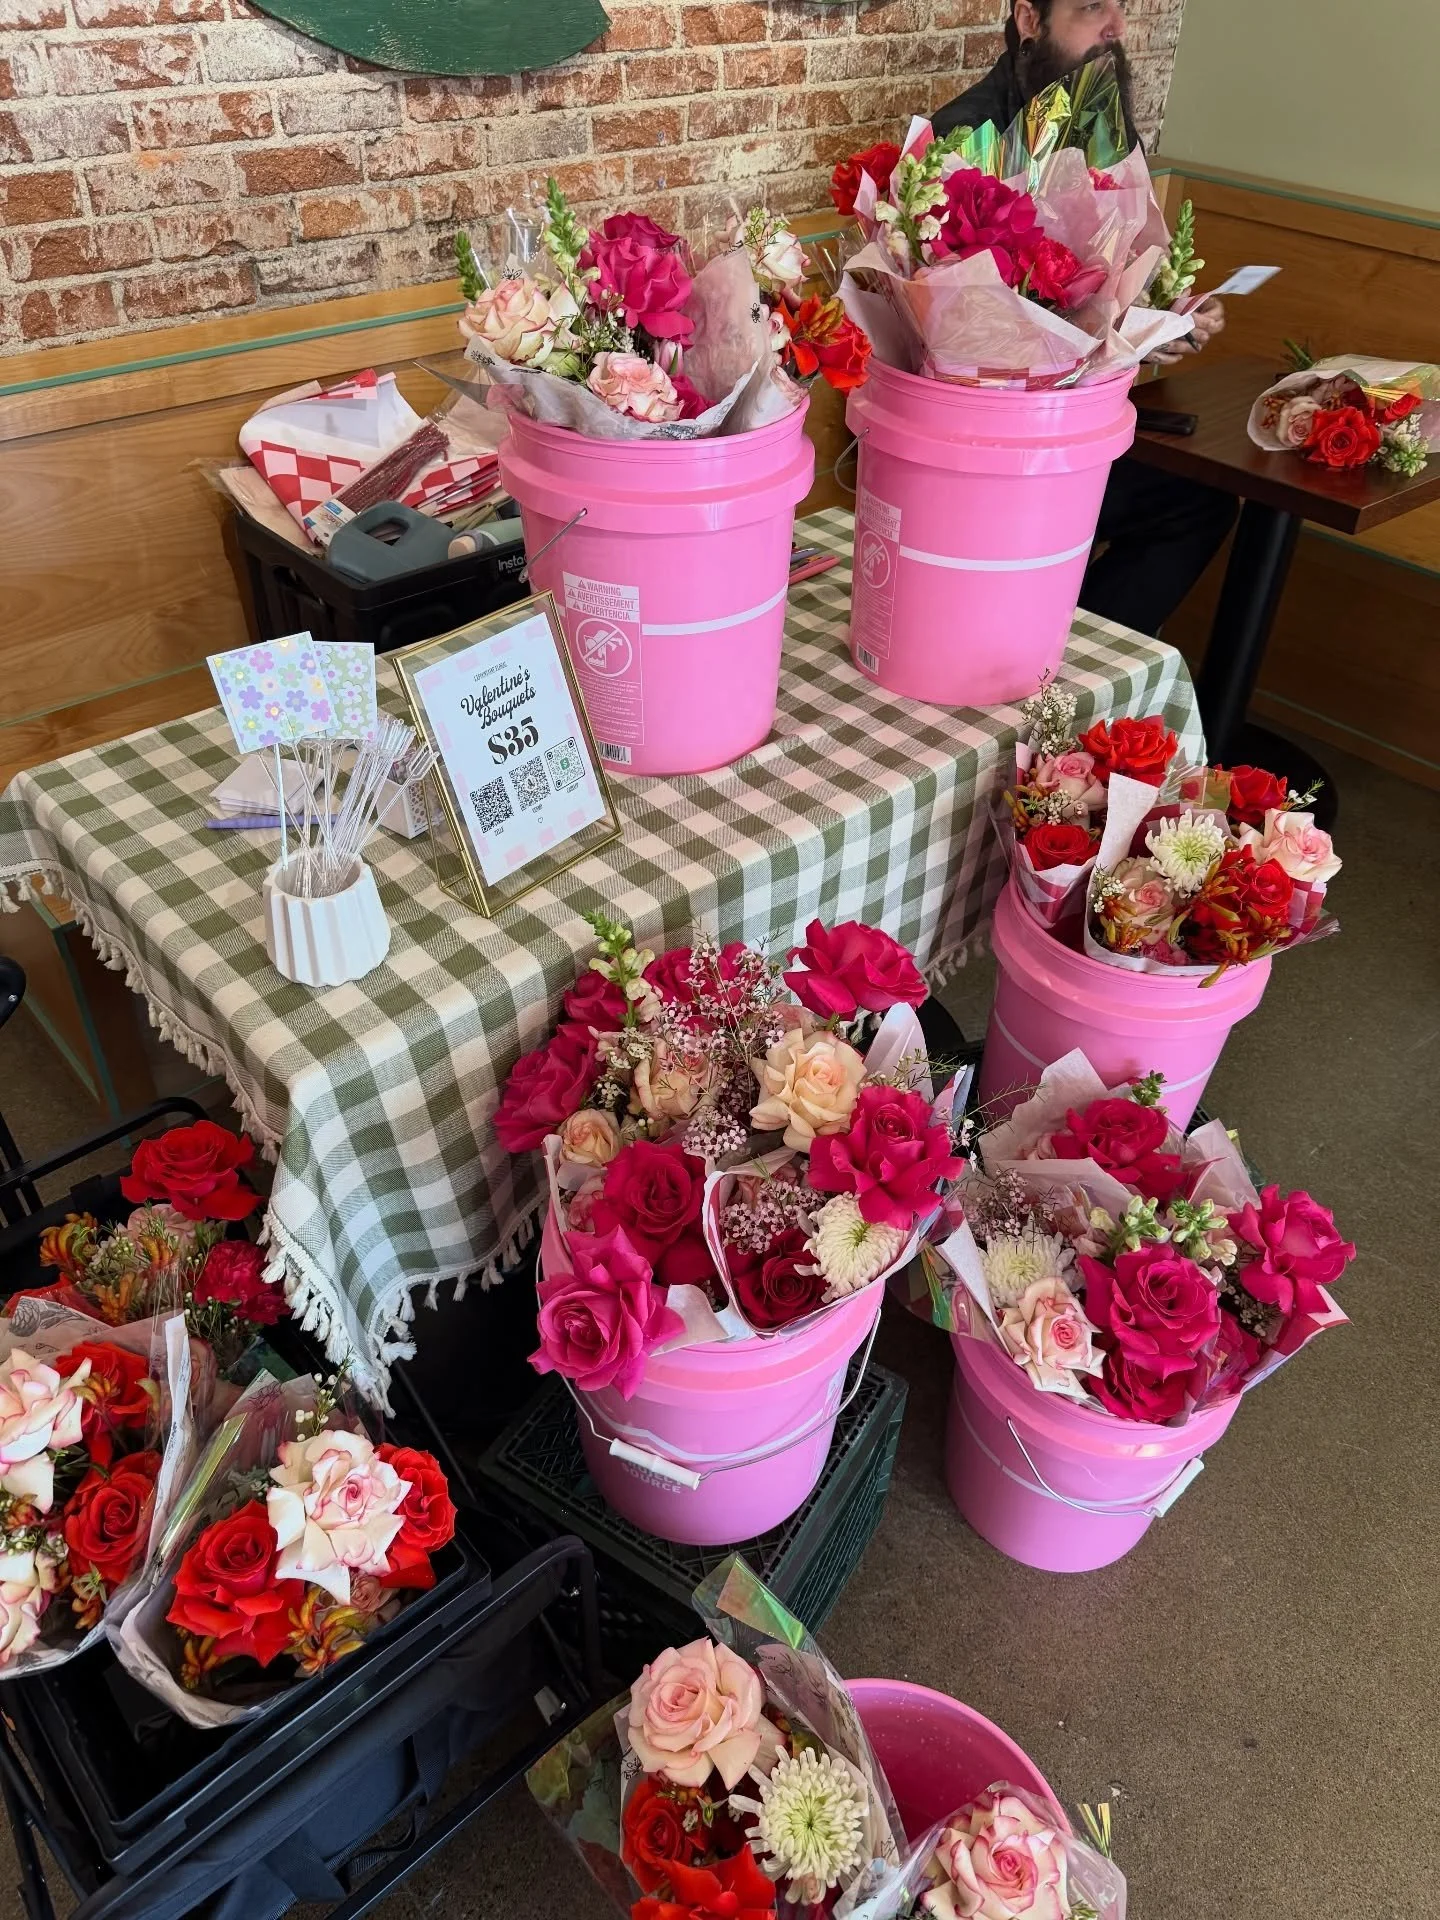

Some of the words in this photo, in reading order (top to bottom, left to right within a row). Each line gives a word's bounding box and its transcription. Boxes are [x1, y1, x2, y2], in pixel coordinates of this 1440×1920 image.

[498, 555, 527, 571] Insta
[577, 590, 634, 609] AVERTISSEMENT
[586, 582, 621, 596] WARNING
[582, 603, 630, 620] ADVERTENCIA
[460, 665, 530, 715] Valentine's
[478, 682, 536, 729] Bouquets
[488, 716, 539, 765] $35
[621, 1462, 681, 1494] SOURCE
[627, 1461, 681, 1486] OJECT
